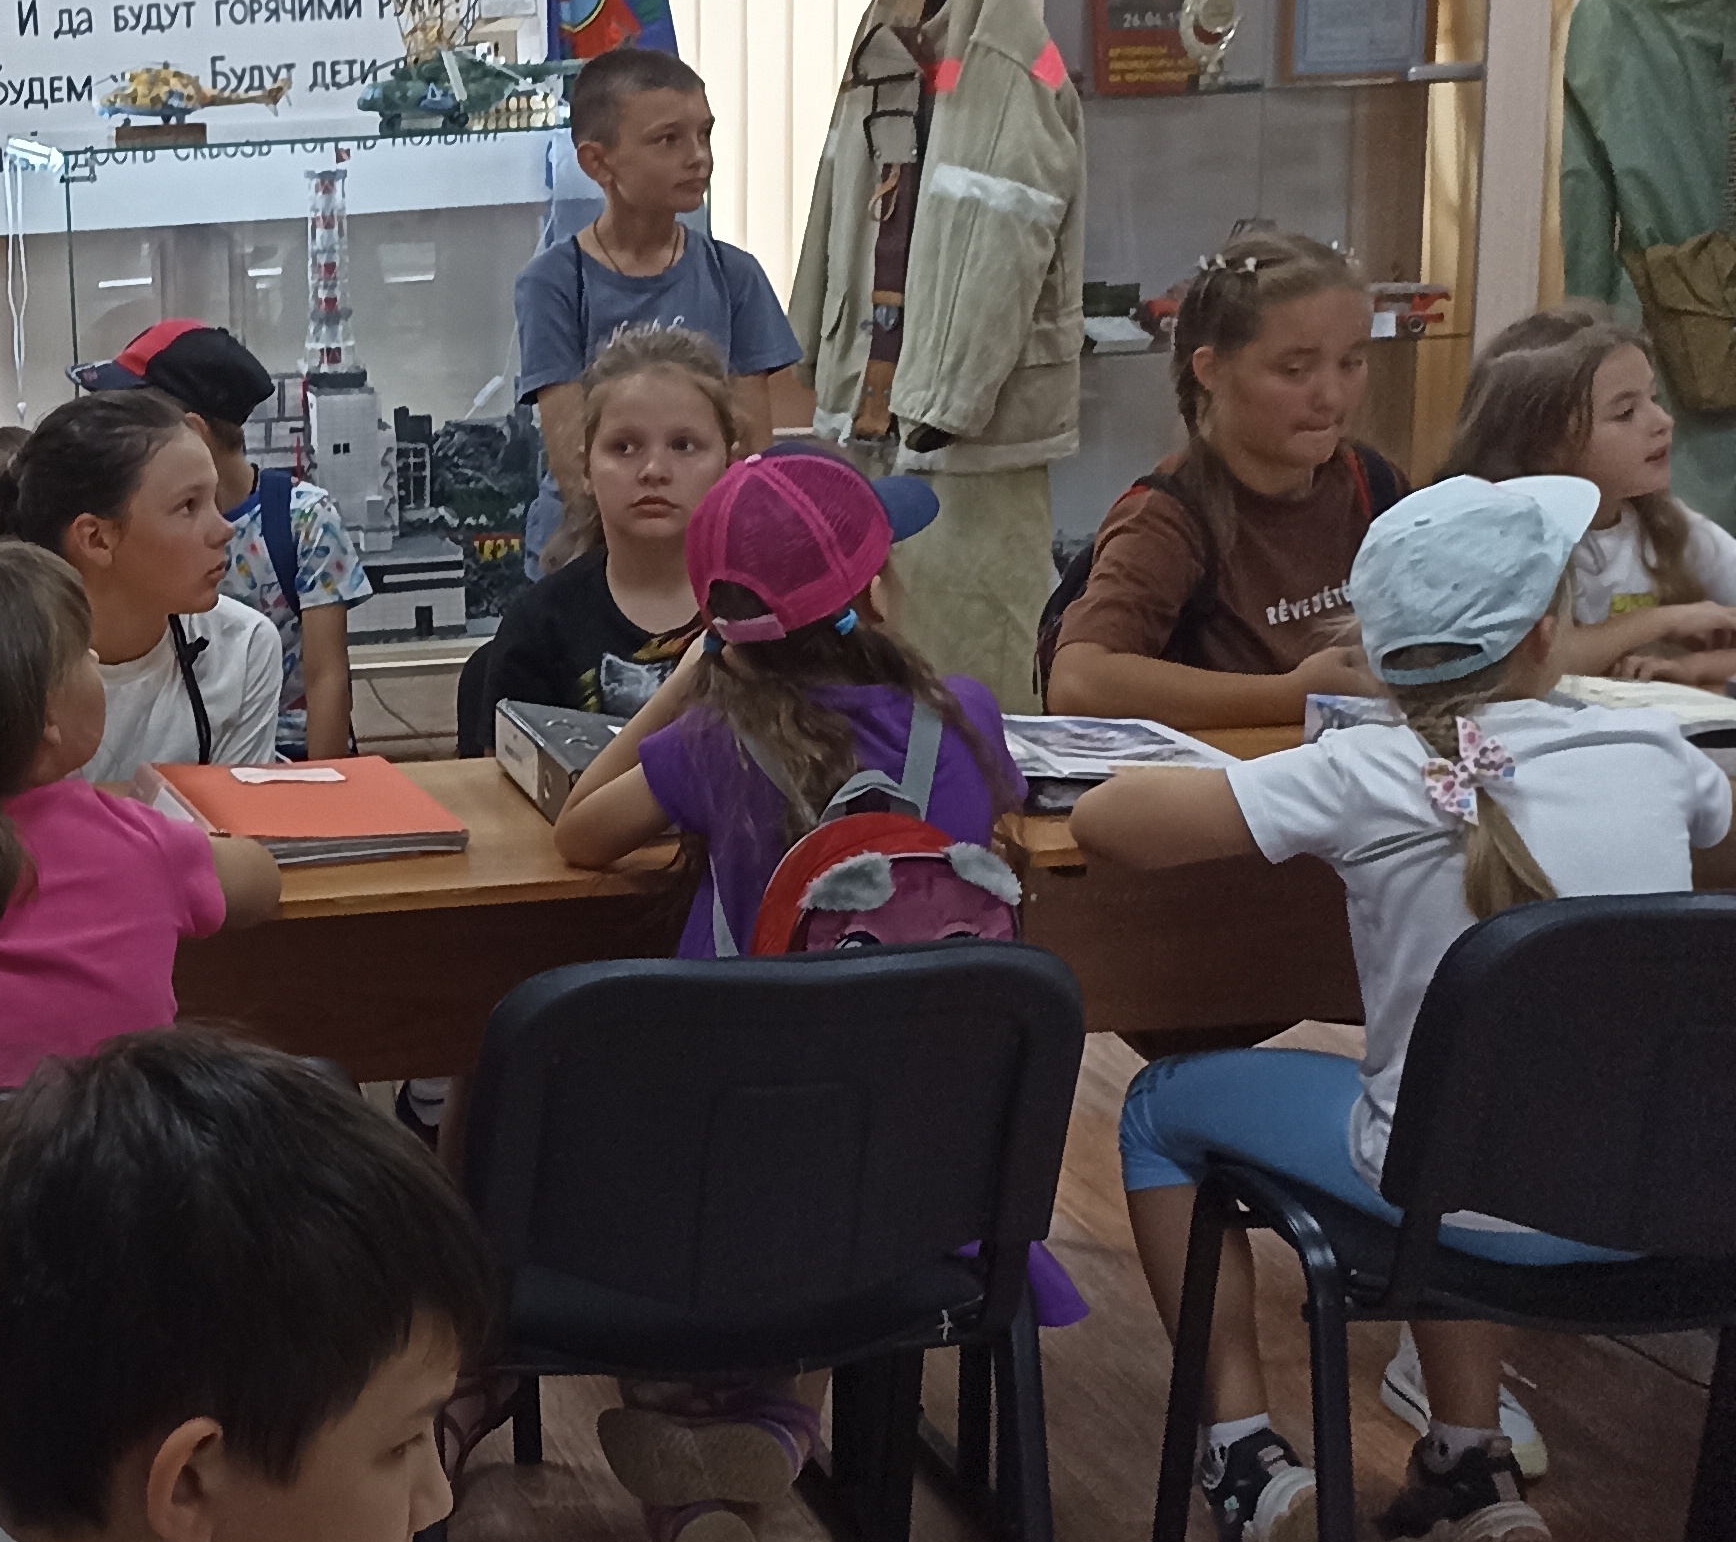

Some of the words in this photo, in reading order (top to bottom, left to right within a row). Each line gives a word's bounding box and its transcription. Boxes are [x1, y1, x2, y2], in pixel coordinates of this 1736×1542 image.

[17, 0, 39, 37] И
[53, 7, 94, 40] да
[113, 0, 196, 36] БУДУТ
